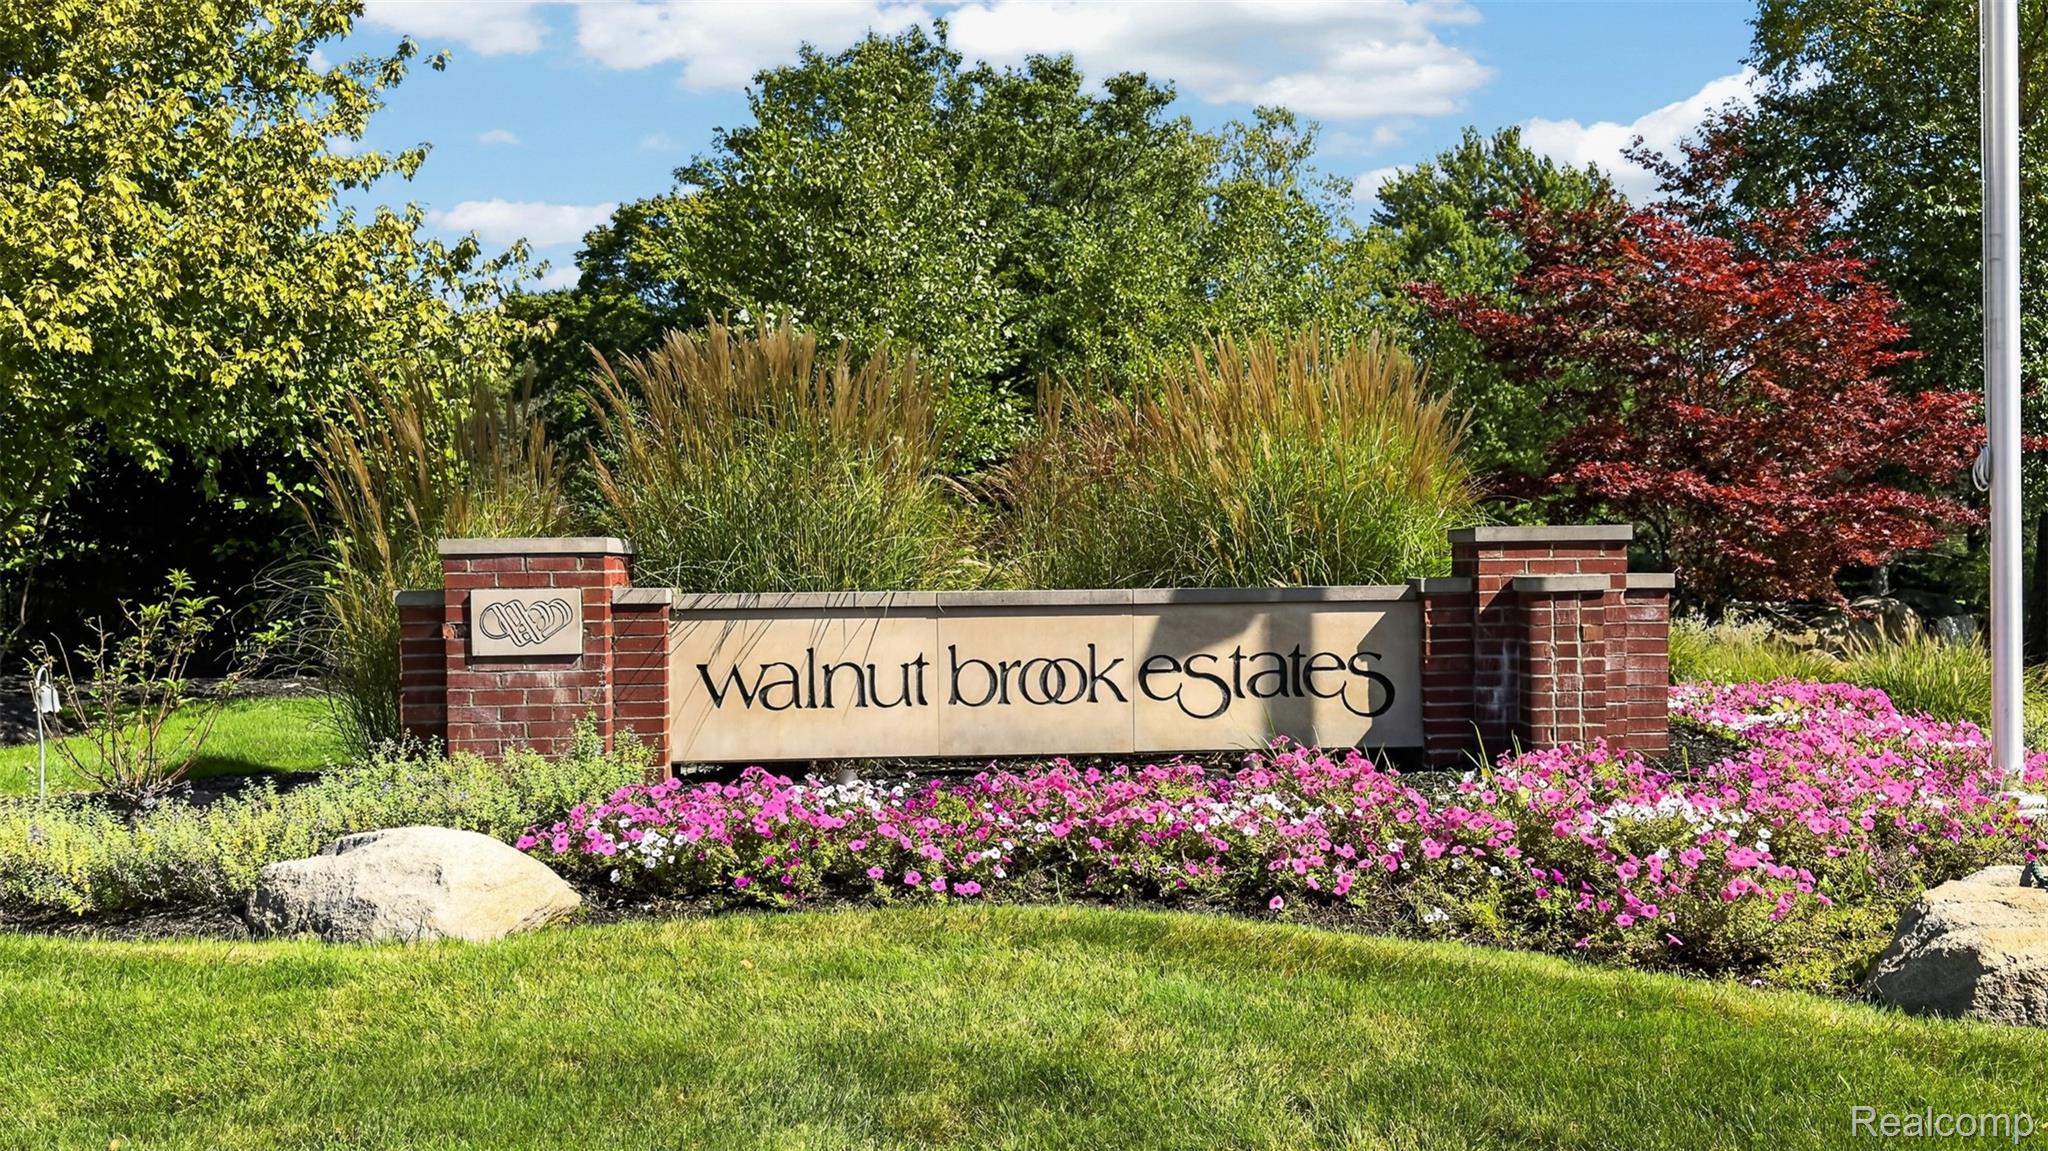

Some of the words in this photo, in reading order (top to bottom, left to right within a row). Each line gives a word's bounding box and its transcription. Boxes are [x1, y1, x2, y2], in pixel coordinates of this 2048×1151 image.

[697, 647, 930, 711] walnut
[948, 644, 1128, 706] brook
[1138, 644, 1395, 719] estates
